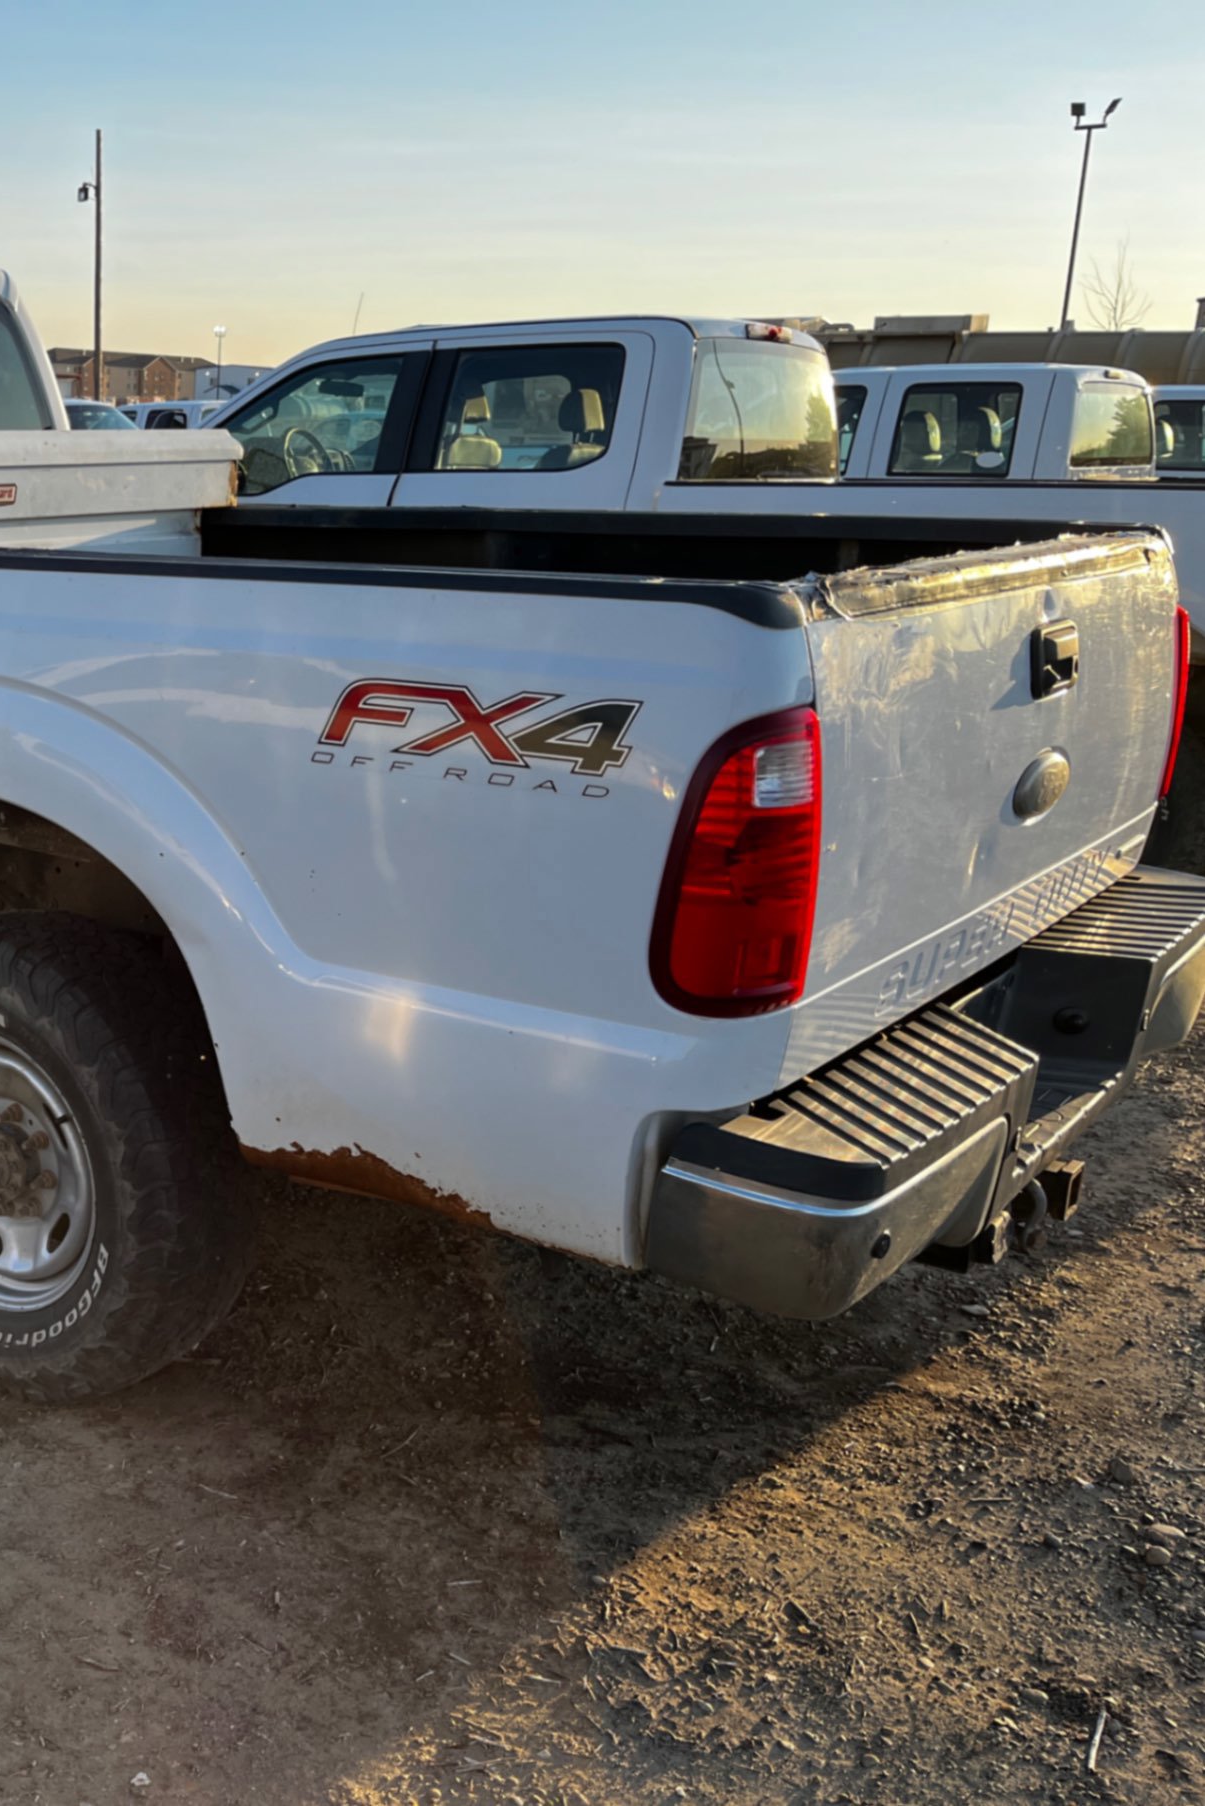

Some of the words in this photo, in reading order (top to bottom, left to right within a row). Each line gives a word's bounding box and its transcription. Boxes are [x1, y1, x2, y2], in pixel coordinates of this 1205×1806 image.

[318, 678, 644, 776] FX4
[310, 751, 414, 773] OFF
[443, 767, 610, 798] ROAD
